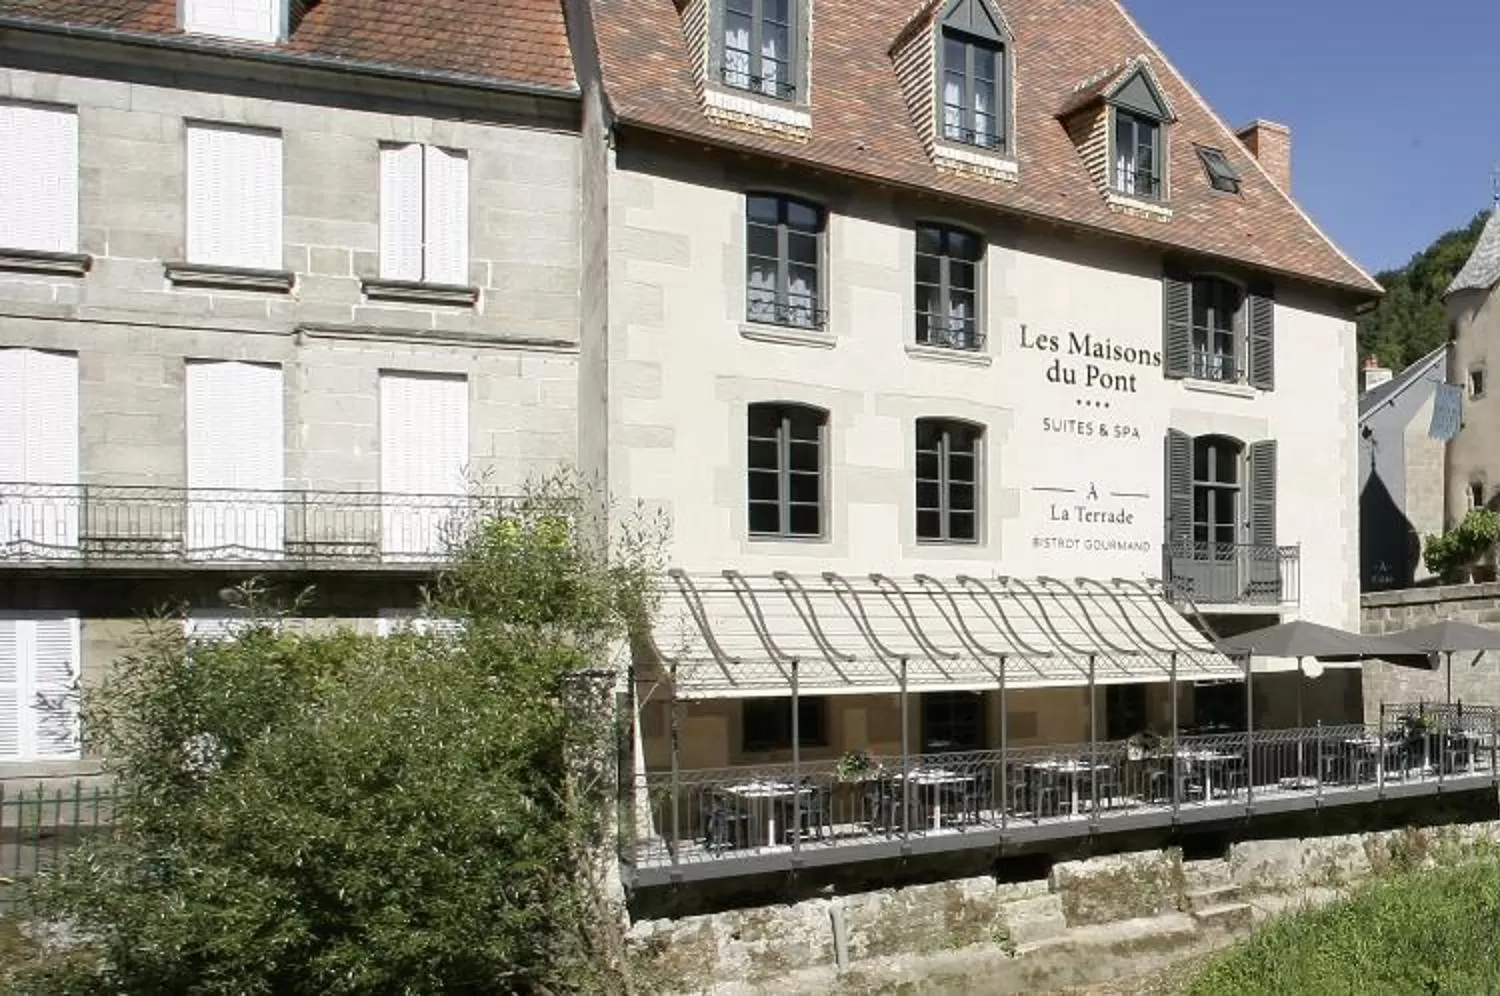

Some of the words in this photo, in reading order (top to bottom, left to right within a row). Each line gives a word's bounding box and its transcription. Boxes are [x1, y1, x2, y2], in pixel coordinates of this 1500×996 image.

[1019, 323, 1060, 353] Les
[1067, 330, 1163, 368] Maisons
[1045, 358, 1078, 386] du
[1084, 363, 1137, 393] Pont
[1042, 417, 1094, 437] SUITES
[1098, 423, 1109, 439] &
[1113, 425, 1141, 440] SPA
[1050, 503, 1070, 521] La
[1073, 505, 1134, 525] Terrade
[1032, 537, 1081, 549] BISTROT
[1085, 539, 1151, 553] GOURMAND
